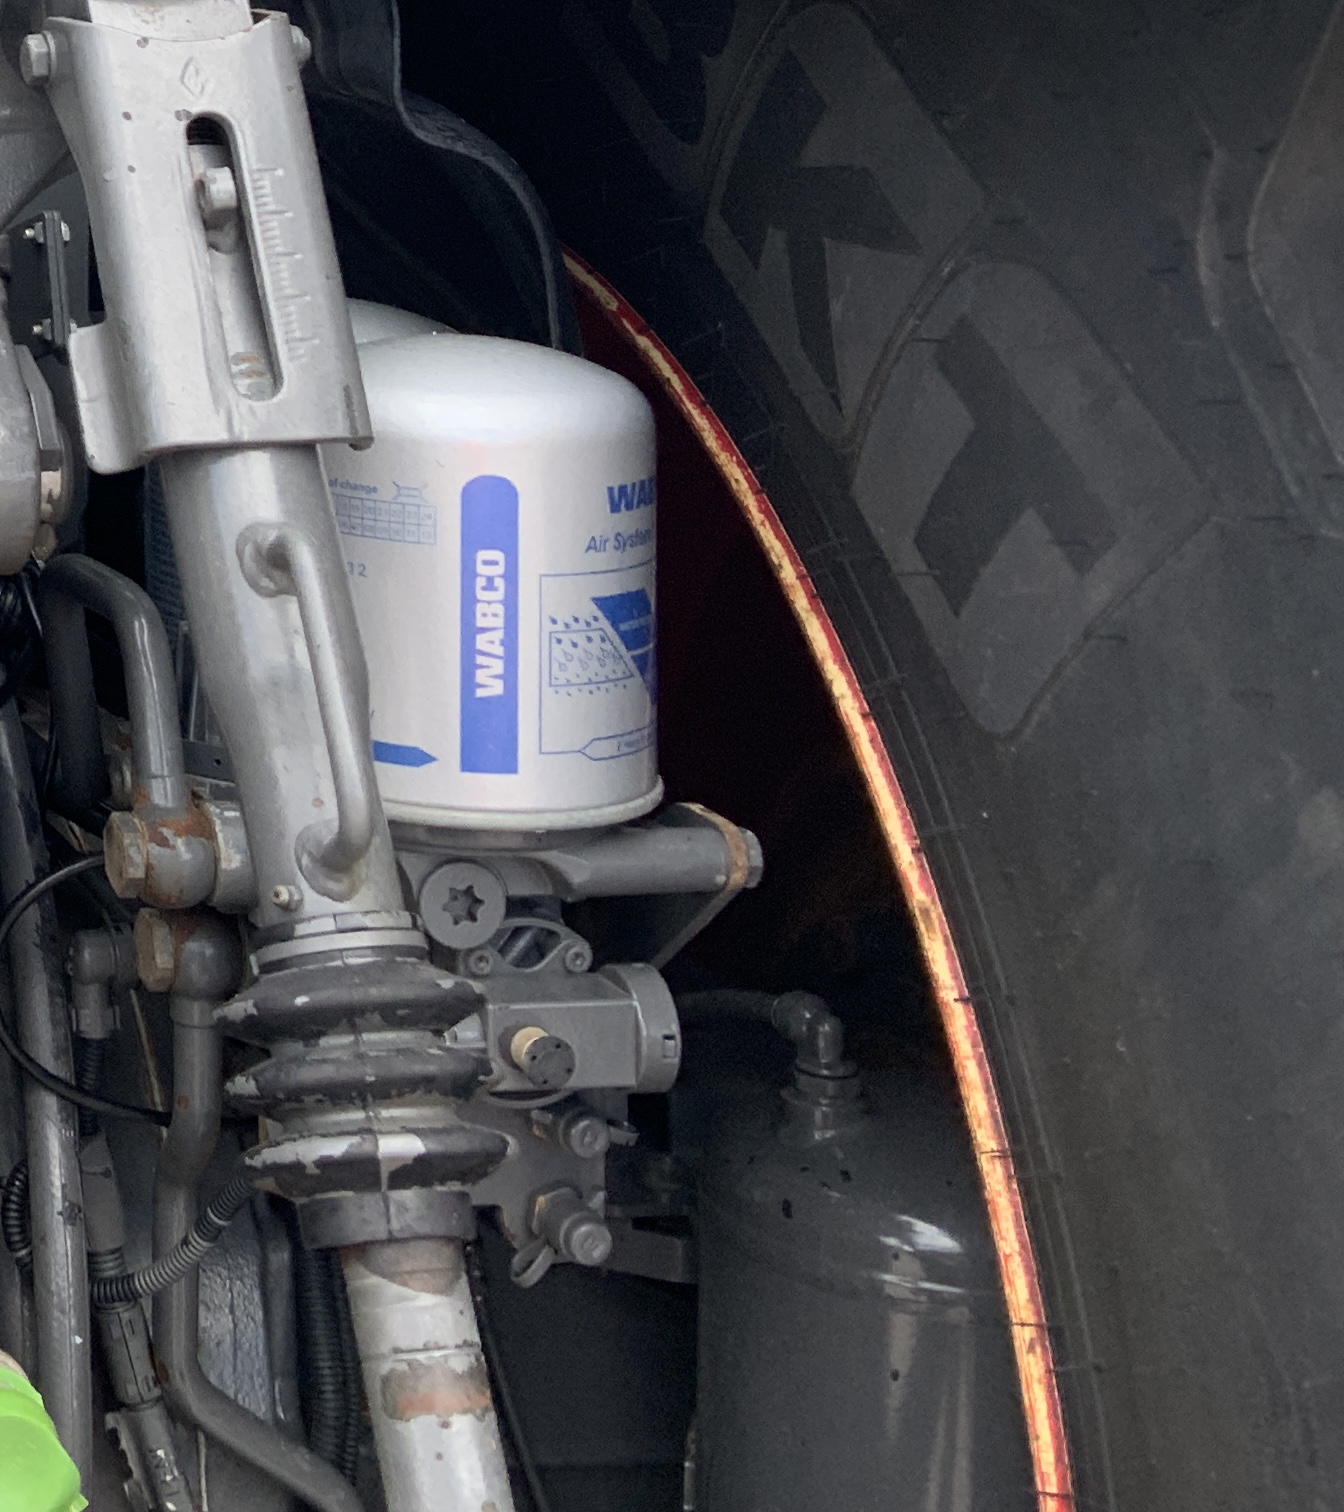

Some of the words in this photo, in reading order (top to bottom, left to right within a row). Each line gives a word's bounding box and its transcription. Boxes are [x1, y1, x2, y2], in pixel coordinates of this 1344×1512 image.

[339, 479, 378, 495] change
[584, 535, 610, 554] Air
[475, 549, 506, 699] WABCO
